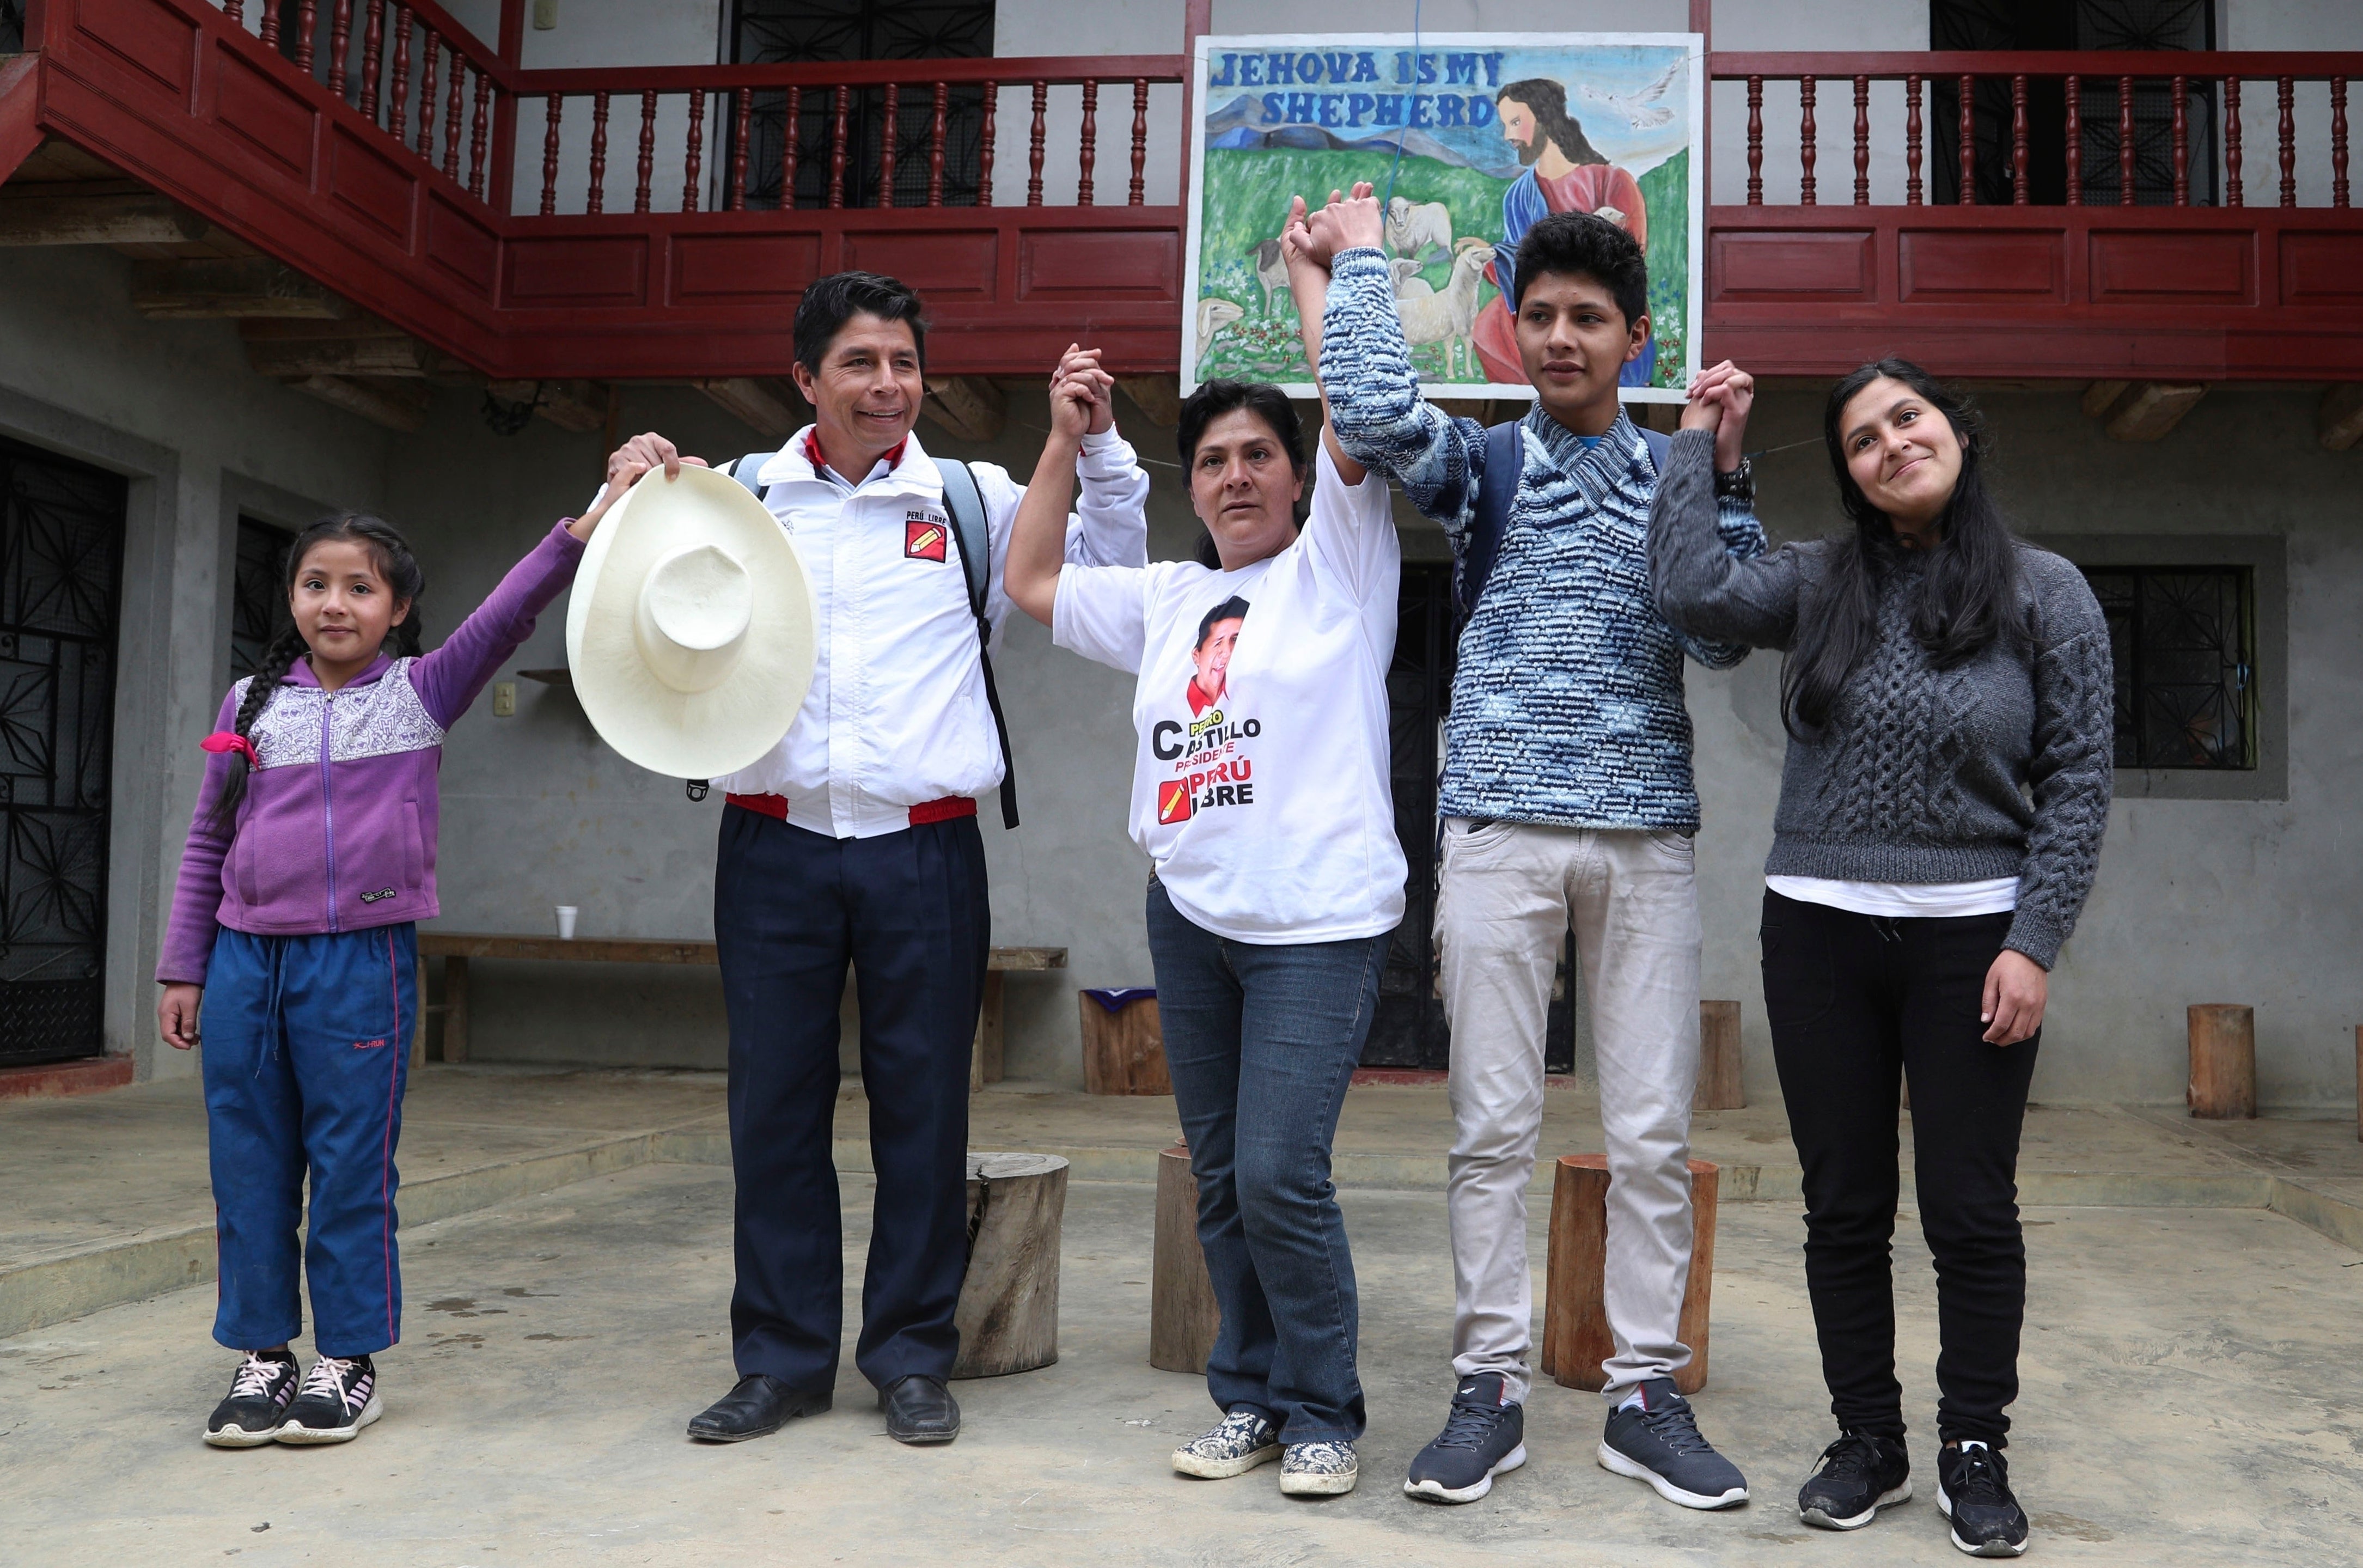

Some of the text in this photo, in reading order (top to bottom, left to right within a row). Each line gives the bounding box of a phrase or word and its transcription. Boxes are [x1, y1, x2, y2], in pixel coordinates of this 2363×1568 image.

[1210, 52, 1505, 87] JEHOVA IS MY
[1261, 91, 1495, 128] SHEPHERD
[906, 510, 947, 526] PERÚ LIBRE
[1189, 709, 1224, 737] PERO
[1175, 741, 1235, 772] PSIDEE
